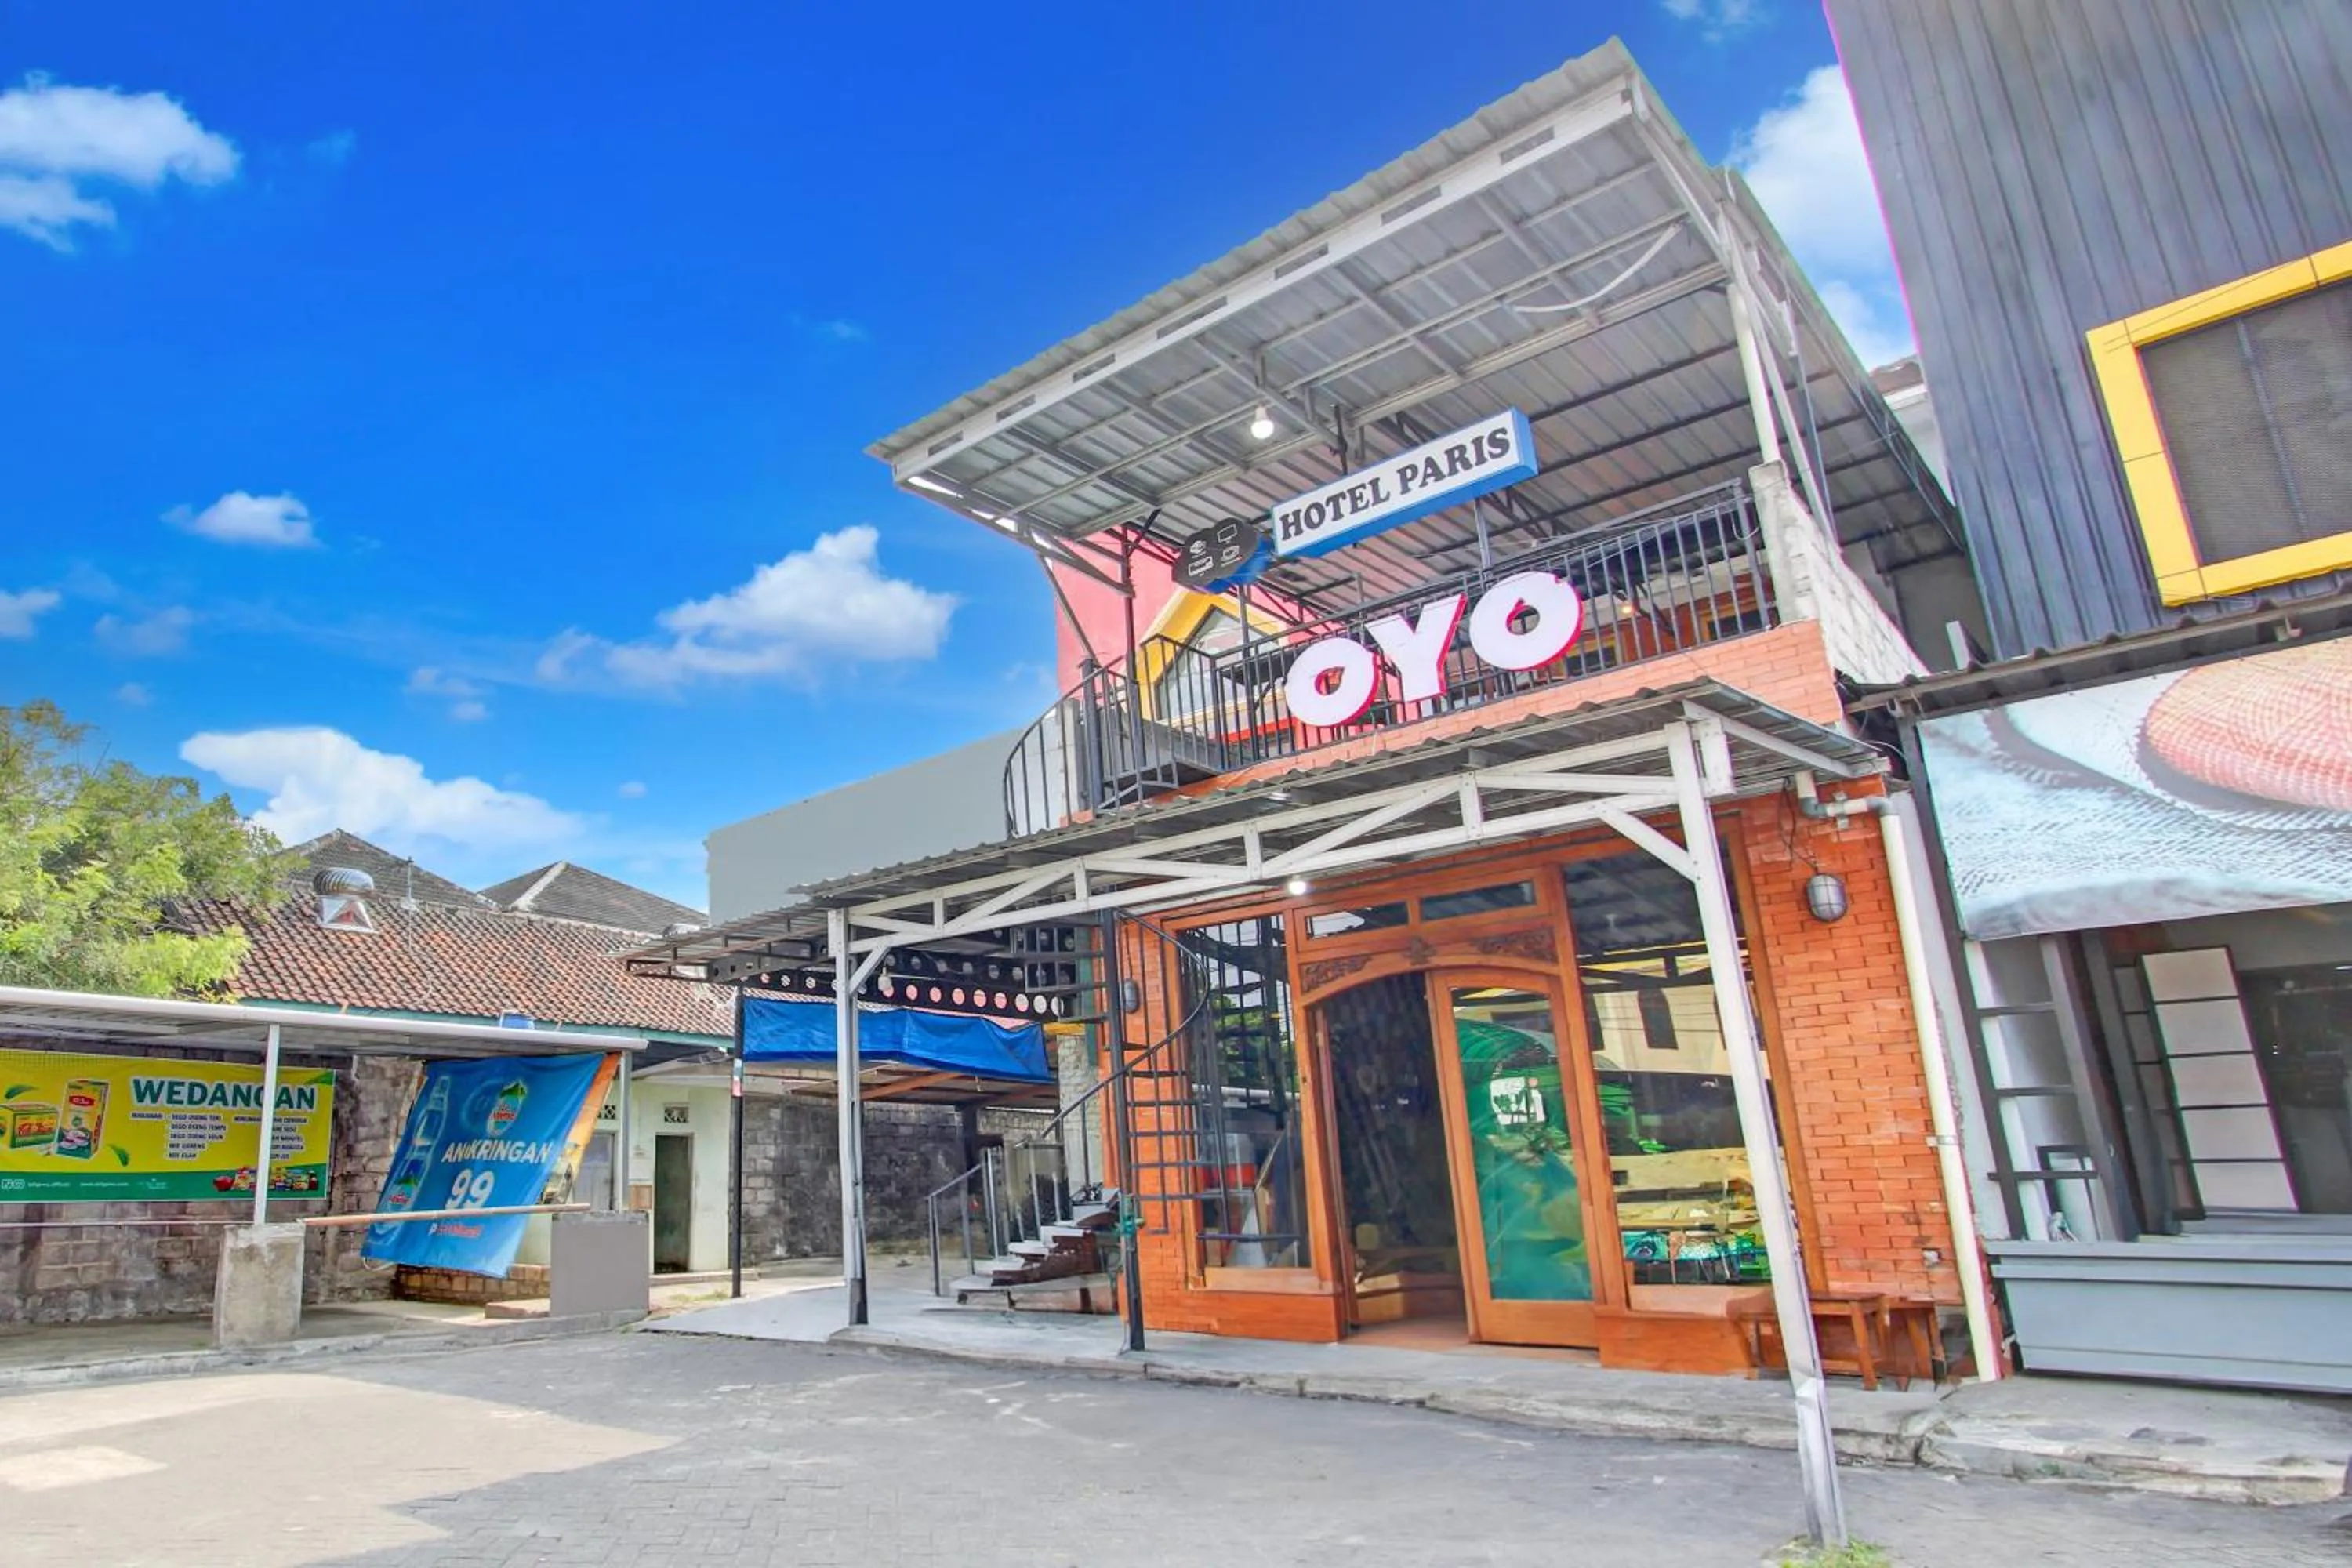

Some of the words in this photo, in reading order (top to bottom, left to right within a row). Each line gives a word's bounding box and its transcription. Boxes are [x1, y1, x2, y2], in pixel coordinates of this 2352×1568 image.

[1279, 477, 1390, 541] HOTEL
[1396, 427, 1510, 495] PARIS
[1284, 570, 1584, 727] OYO
[445, 1167, 495, 1210] 99
